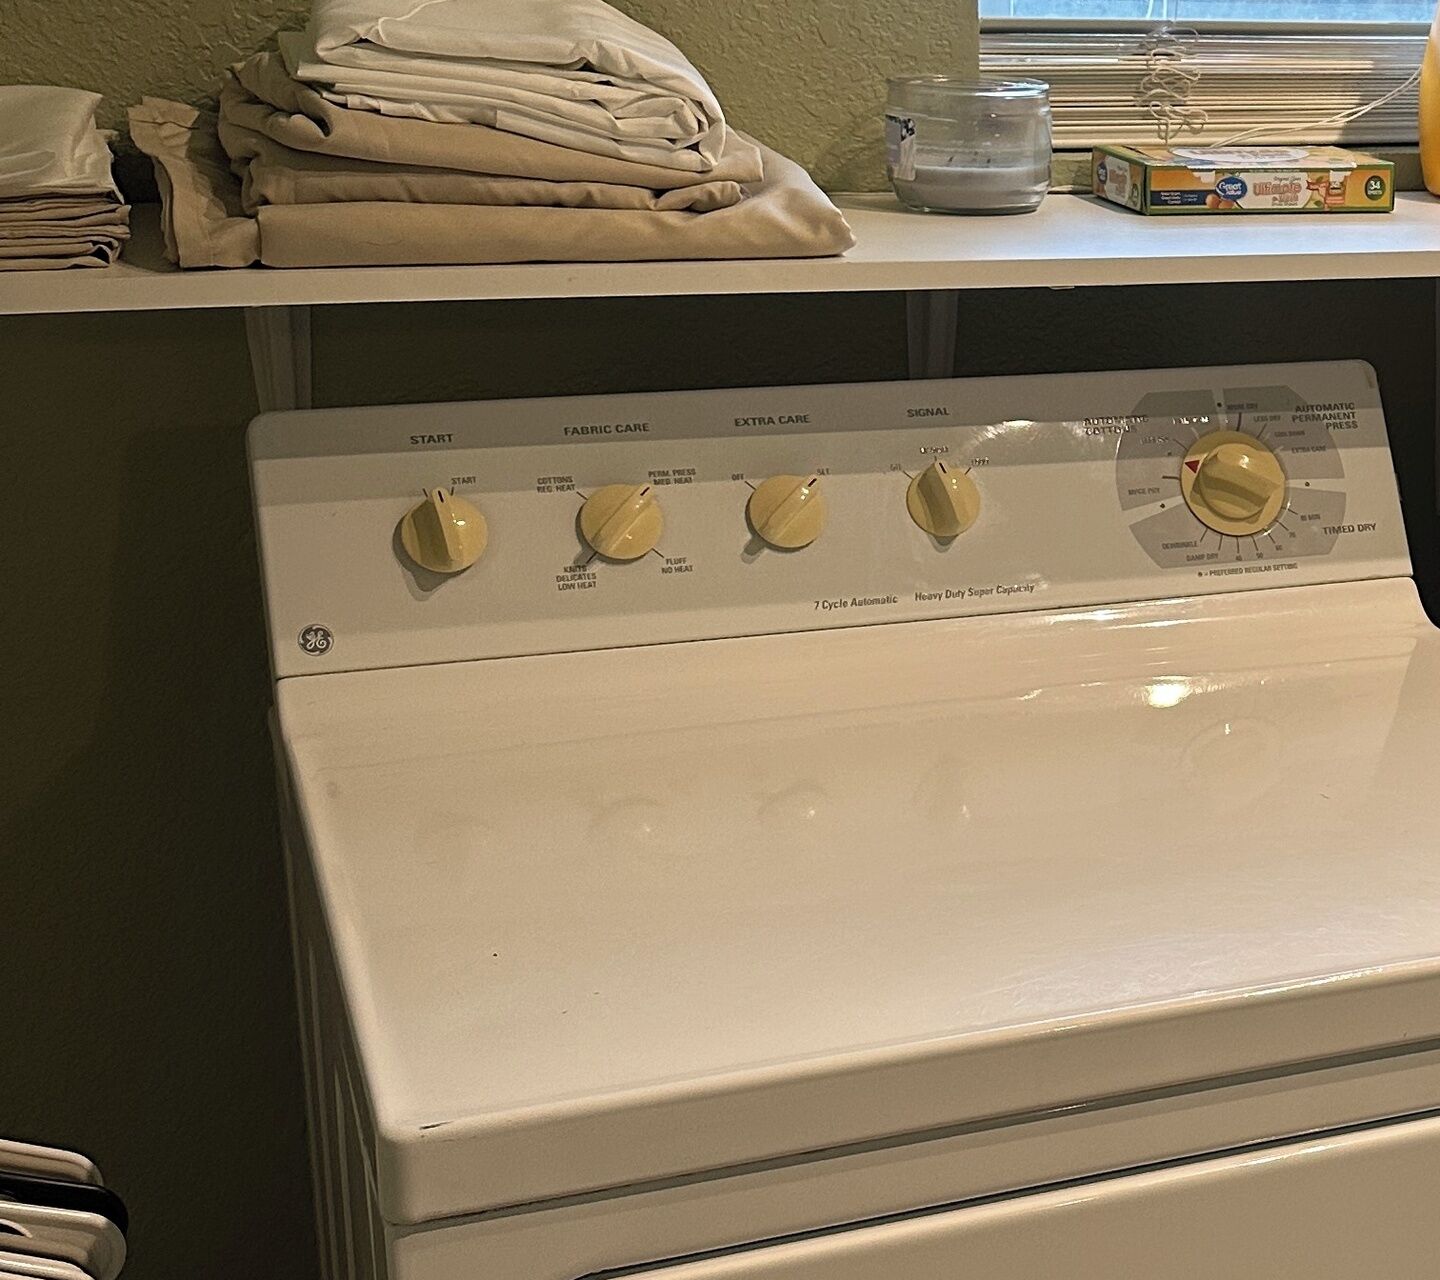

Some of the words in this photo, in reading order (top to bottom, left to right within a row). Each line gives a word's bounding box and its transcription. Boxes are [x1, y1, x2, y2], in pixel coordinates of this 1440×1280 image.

[1219, 181, 1242, 192] Great
[906, 407, 950, 418] SIGNAL
[1295, 402, 1356, 413] AUTOMATIC
[734, 417, 776, 427] EXTRA
[778, 414, 812, 425] CARE
[1292, 411, 1357, 423] PERMANENT
[563, 425, 612, 436] FABRIC
[615, 422, 650, 433] CARE
[1325, 420, 1359, 431] PRESS
[410, 433, 454, 445] START
[671, 468, 697, 476] PRESS
[451, 476, 477, 485] START
[536, 476, 574, 485] COTTONS
[673, 477, 693, 485] HEAT
[555, 484, 576, 492] HEAT
[1322, 525, 1355, 536] TIMED
[1356, 523, 1377, 533] DRY
[665, 557, 687, 566] FLUFF
[674, 565, 694, 573] HEAT
[555, 573, 597, 583] DELICATES
[557, 582, 576, 591] LOW
[577, 580, 597, 589] HEAT
[914, 591, 943, 602] Heavy
[945, 588, 966, 600] Duty
[967, 586, 994, 598] Super
[814, 600, 820, 610] 7
[821, 599, 848, 611] Cycle
[850, 594, 898, 608] Automatic
